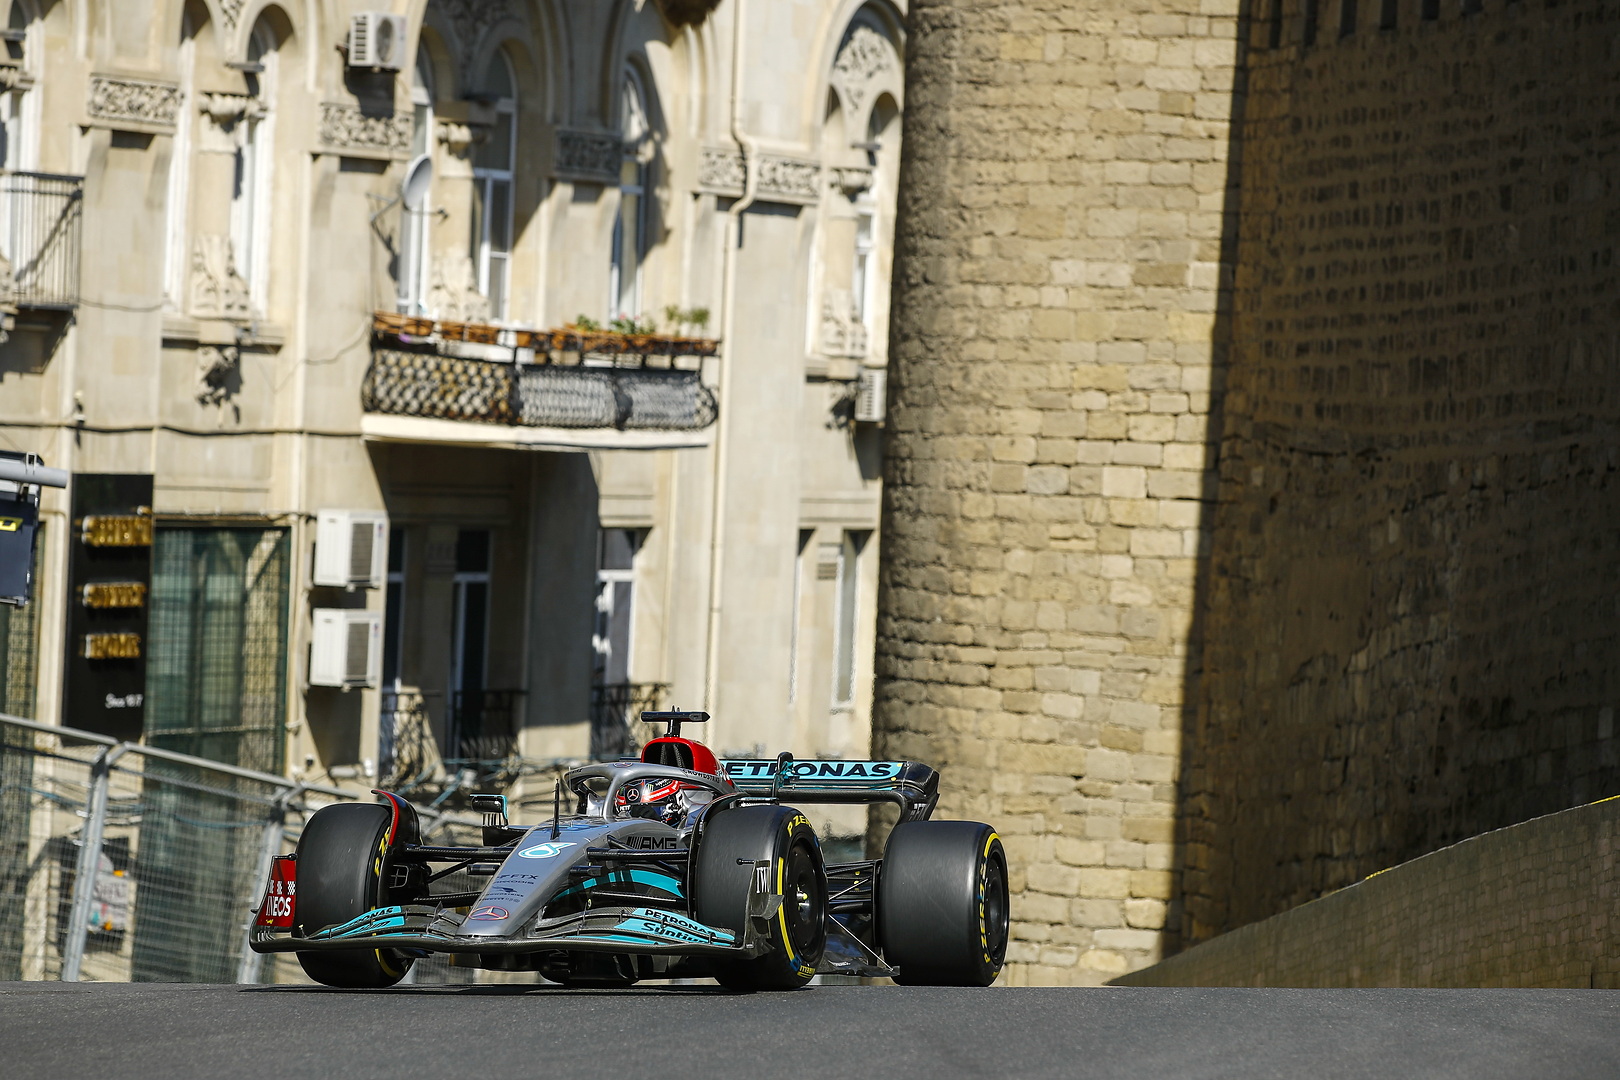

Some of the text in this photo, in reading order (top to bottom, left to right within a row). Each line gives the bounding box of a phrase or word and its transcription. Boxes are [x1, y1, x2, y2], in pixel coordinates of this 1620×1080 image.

[725, 762, 892, 777] ETONAS
[787, 815, 813, 837] P ZER
[640, 836, 677, 849] AMG
[266, 895, 292, 917] INEOS
